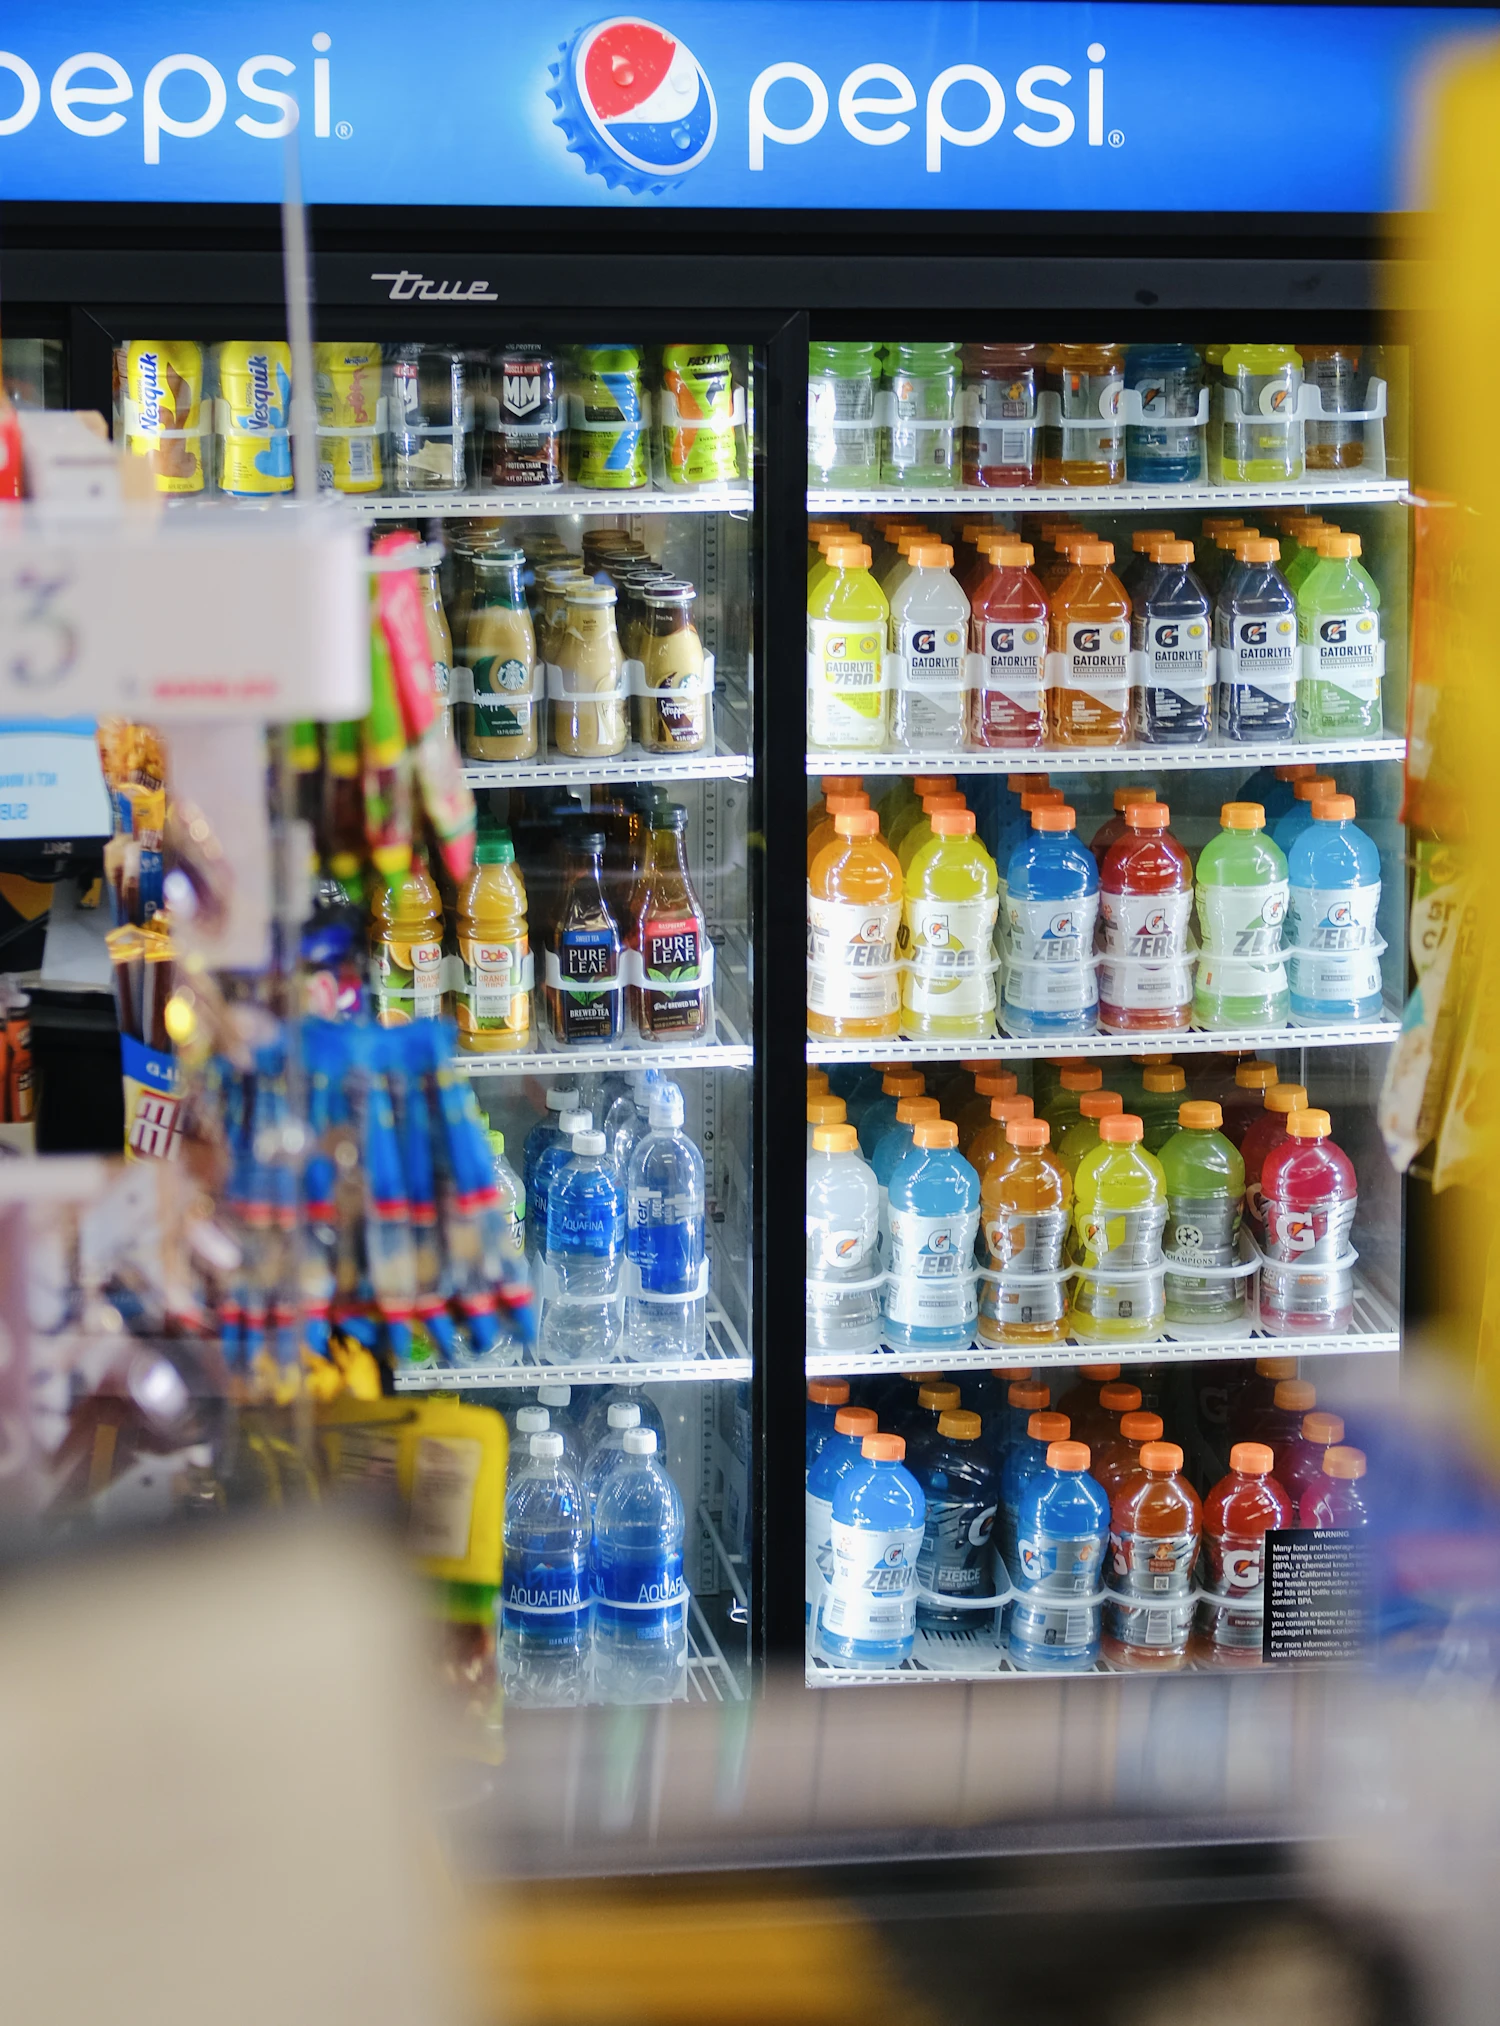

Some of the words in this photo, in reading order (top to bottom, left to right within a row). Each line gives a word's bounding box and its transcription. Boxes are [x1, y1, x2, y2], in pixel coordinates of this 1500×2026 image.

[749, 42, 1104, 172] pepsi
[371, 270, 498, 301] true
[504, 365, 524, 374] MUSCLE
[524, 365, 539, 374] MILK
[687, 354, 712, 367] FAST
[139, 352, 164, 435] Nesquik
[248, 354, 274, 433] Nesquik
[503, 375, 541, 416] MM
[1134, 379, 1166, 418] G
[1259, 380, 1293, 416] G
[655, 614, 673, 622] Mocha
[912, 630, 935, 654] G
[991, 629, 1014, 652] G
[1073, 629, 1100, 652] G
[1155, 625, 1179, 648] G
[1240, 622, 1267, 645] G
[1320, 620, 1347, 643] G
[826, 637, 847, 658] G
[1155, 651, 1202, 661] GATORLYTE
[1240, 647, 1291, 659] GATORLYTE
[1321, 644, 1372, 658] GATORLYTE
[826, 662, 873, 673] GATORLYTE
[912, 657, 959, 667] GATORLYTE
[991, 656, 1037, 666] GATORLYTE
[1073, 655, 1126, 666] GATORLYTE
[835, 674, 873, 685] ZERO
[1261, 892, 1285, 927] G
[1327, 901, 1353, 927] G
[658, 922, 686, 930] RASPBERRY
[860, 918, 881, 943] G
[922, 914, 950, 947] G
[1050, 912, 1073, 938] G
[1145, 908, 1165, 935] G
[575, 935, 590, 943] SWEET
[591, 935, 600, 943] TEA
[652, 935, 694, 951] PURE
[1233, 927, 1282, 957] ZER
[1310, 927, 1366, 950] ZERO
[418, 949, 440, 961] Dole
[481, 949, 508, 962] Dole
[569, 949, 606, 962] PURE
[845, 942, 891, 966] ZERO
[479, 974, 508, 983] ORANGE
[570, 1008, 597, 1018] BREWED
[597, 1008, 610, 1017] TEA
[668, 1001, 689, 1010] BREWED
[689, 1000, 698, 1008] TEA
[562, 1219, 604, 1231] AQUAFINA
[1079, 1214, 1109, 1253] G
[1276, 1212, 1316, 1251] G
[823, 1229, 865, 1268] G
[928, 1229, 951, 1254] G
[985, 1221, 1012, 1260] G
[1166, 1252, 1213, 1265] CHAMPIONS
[883, 1543, 904, 1567] G
[1273, 1544, 1291, 1553] Many
[1324, 1543, 1354, 1551] beverage
[1314, 1553, 1348, 1561] containing
[1018, 1539, 1041, 1580] G
[1223, 1549, 1260, 1588] G
[1273, 1562, 1294, 1571] (BPA),
[862, 1567, 912, 1591] ZERO
[938, 1568, 982, 1582] FIERCE
[1272, 1571, 1290, 1579] State
[509, 1585, 581, 1607] AQUAFINA
[1310, 1610, 1338, 1618] exposed
[1272, 1629, 1304, 1637] packaged
[1303, 1640, 1341, 1648] information,
